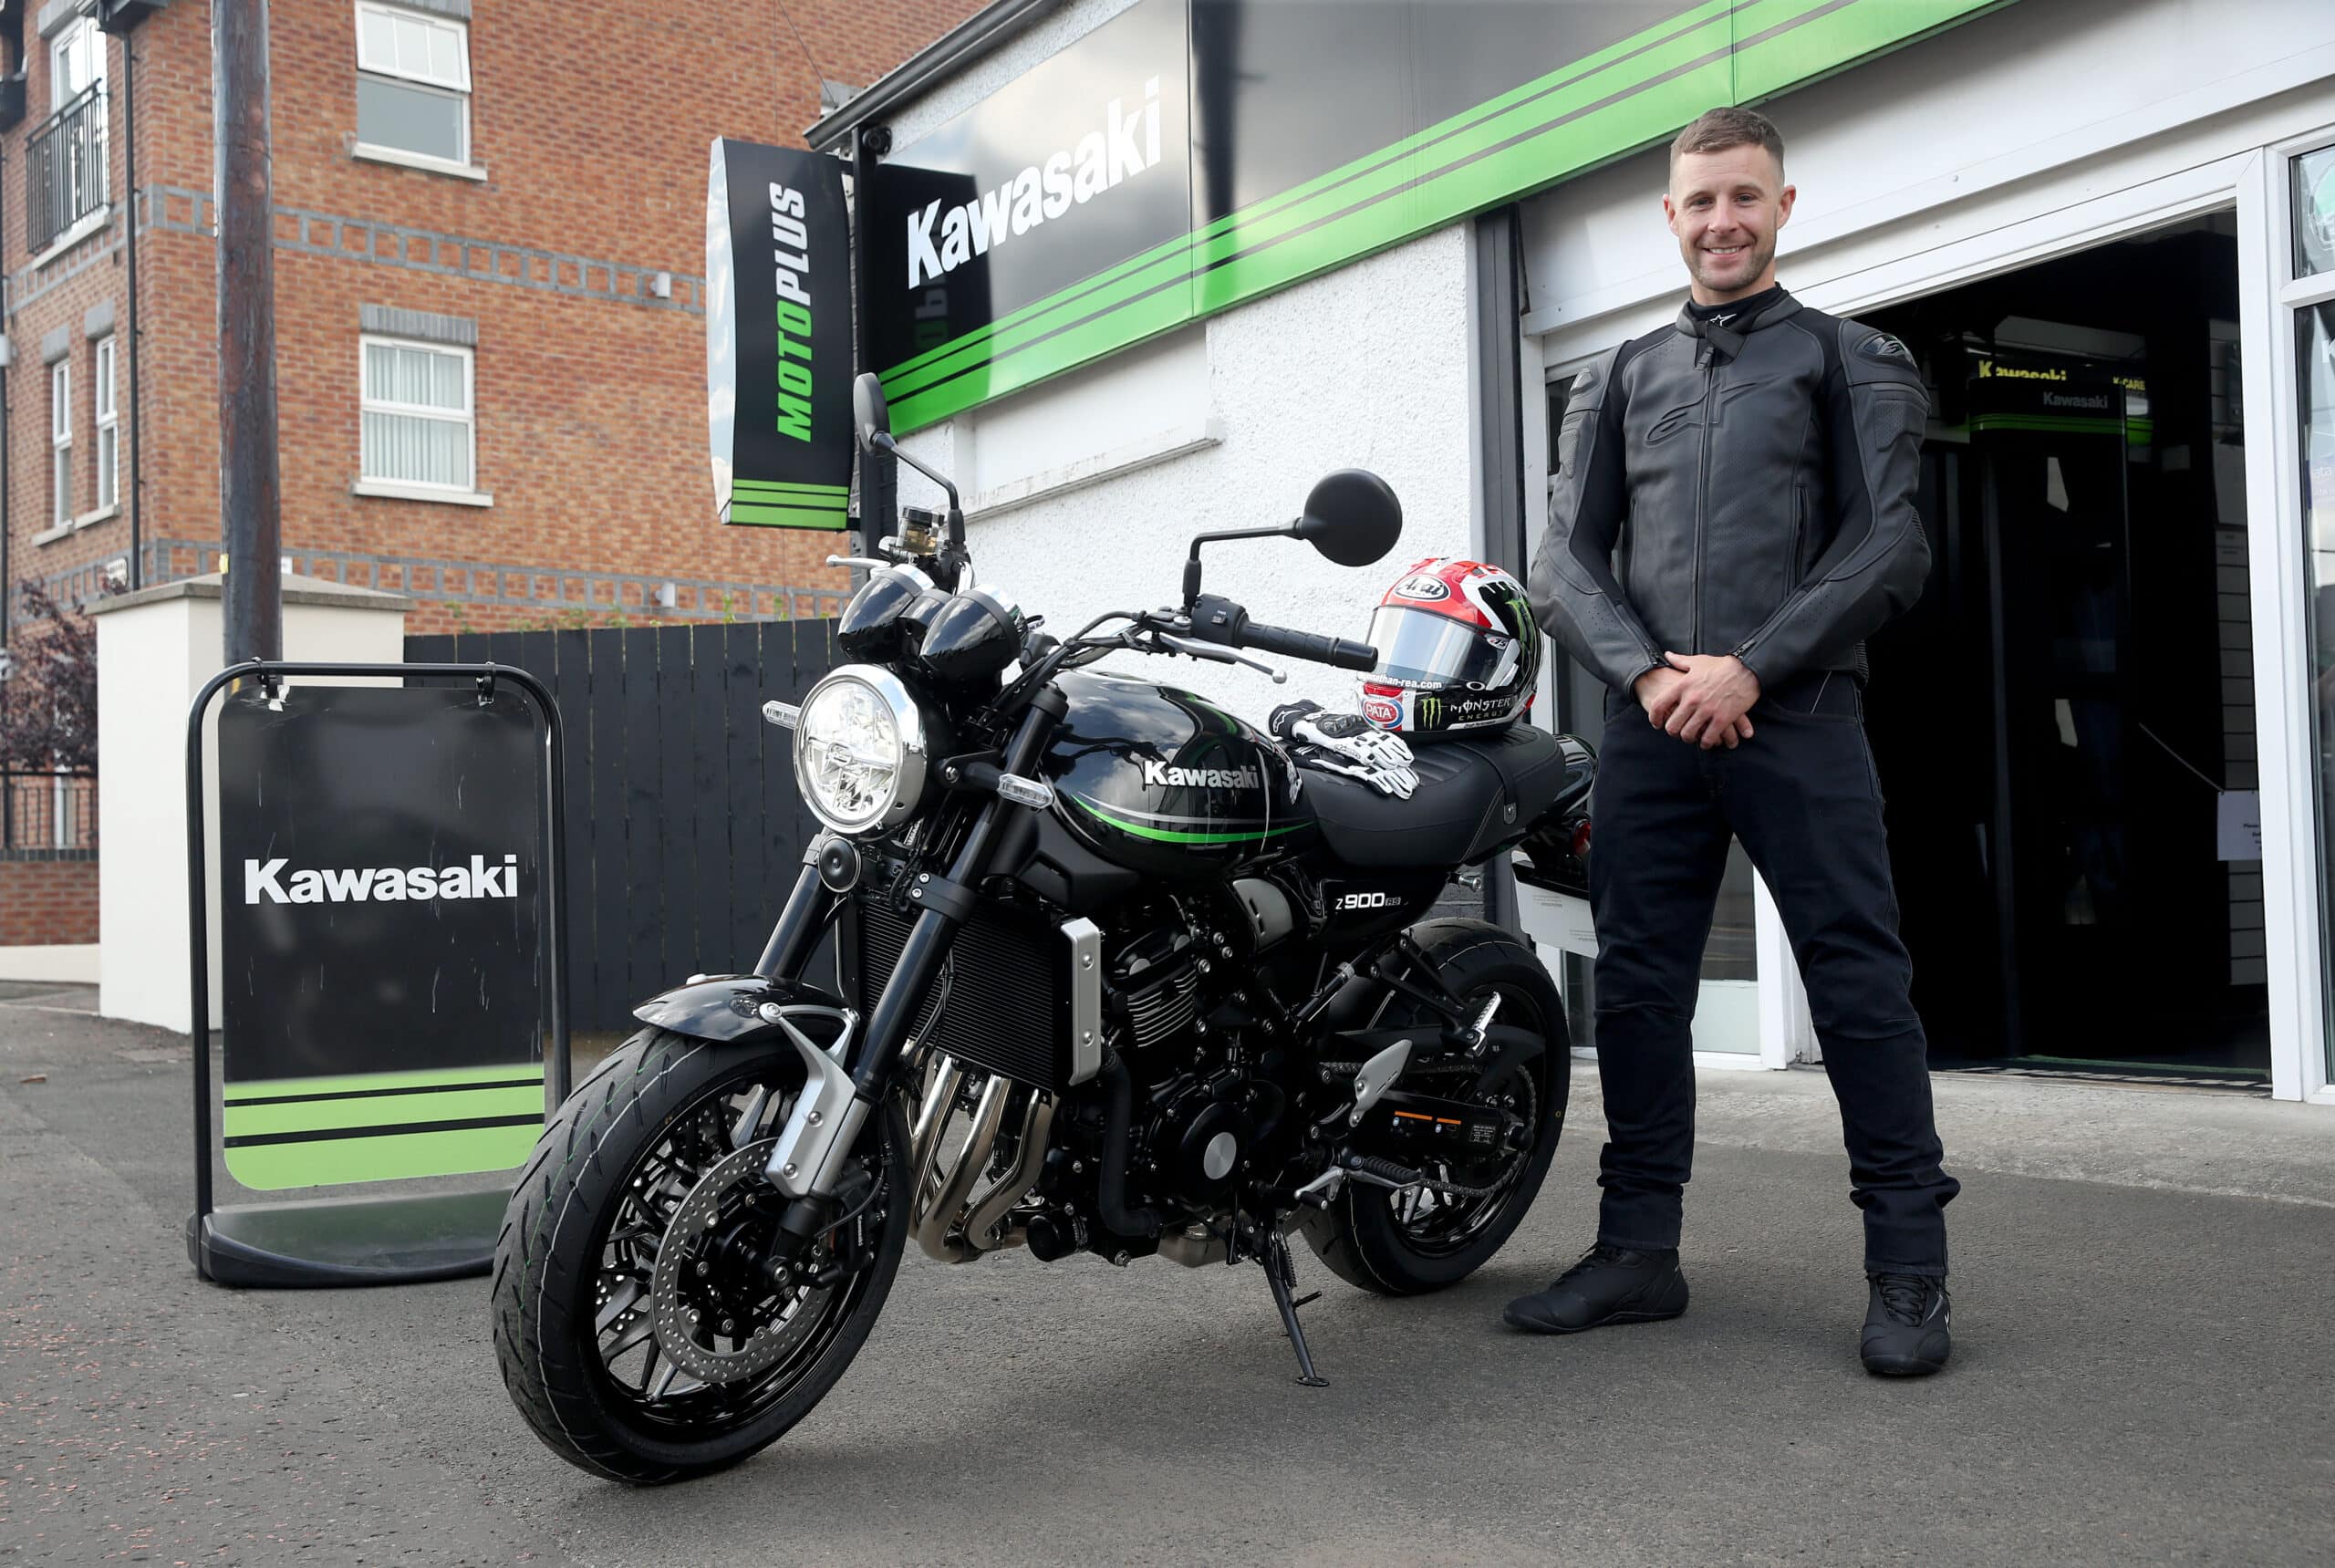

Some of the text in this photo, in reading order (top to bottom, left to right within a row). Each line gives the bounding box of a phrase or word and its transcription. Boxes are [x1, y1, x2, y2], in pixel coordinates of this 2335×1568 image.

[908, 75, 1160, 289] Kawasaki
[769, 182, 812, 441] MOTOPLUS
[2043, 391, 2108, 409] Kawasaki
[1361, 673, 1442, 689] nathan-rea.com
[1365, 703, 1392, 719] PATA
[1145, 760, 1258, 788] Kawasaki
[244, 854, 517, 905] Kawasaki
